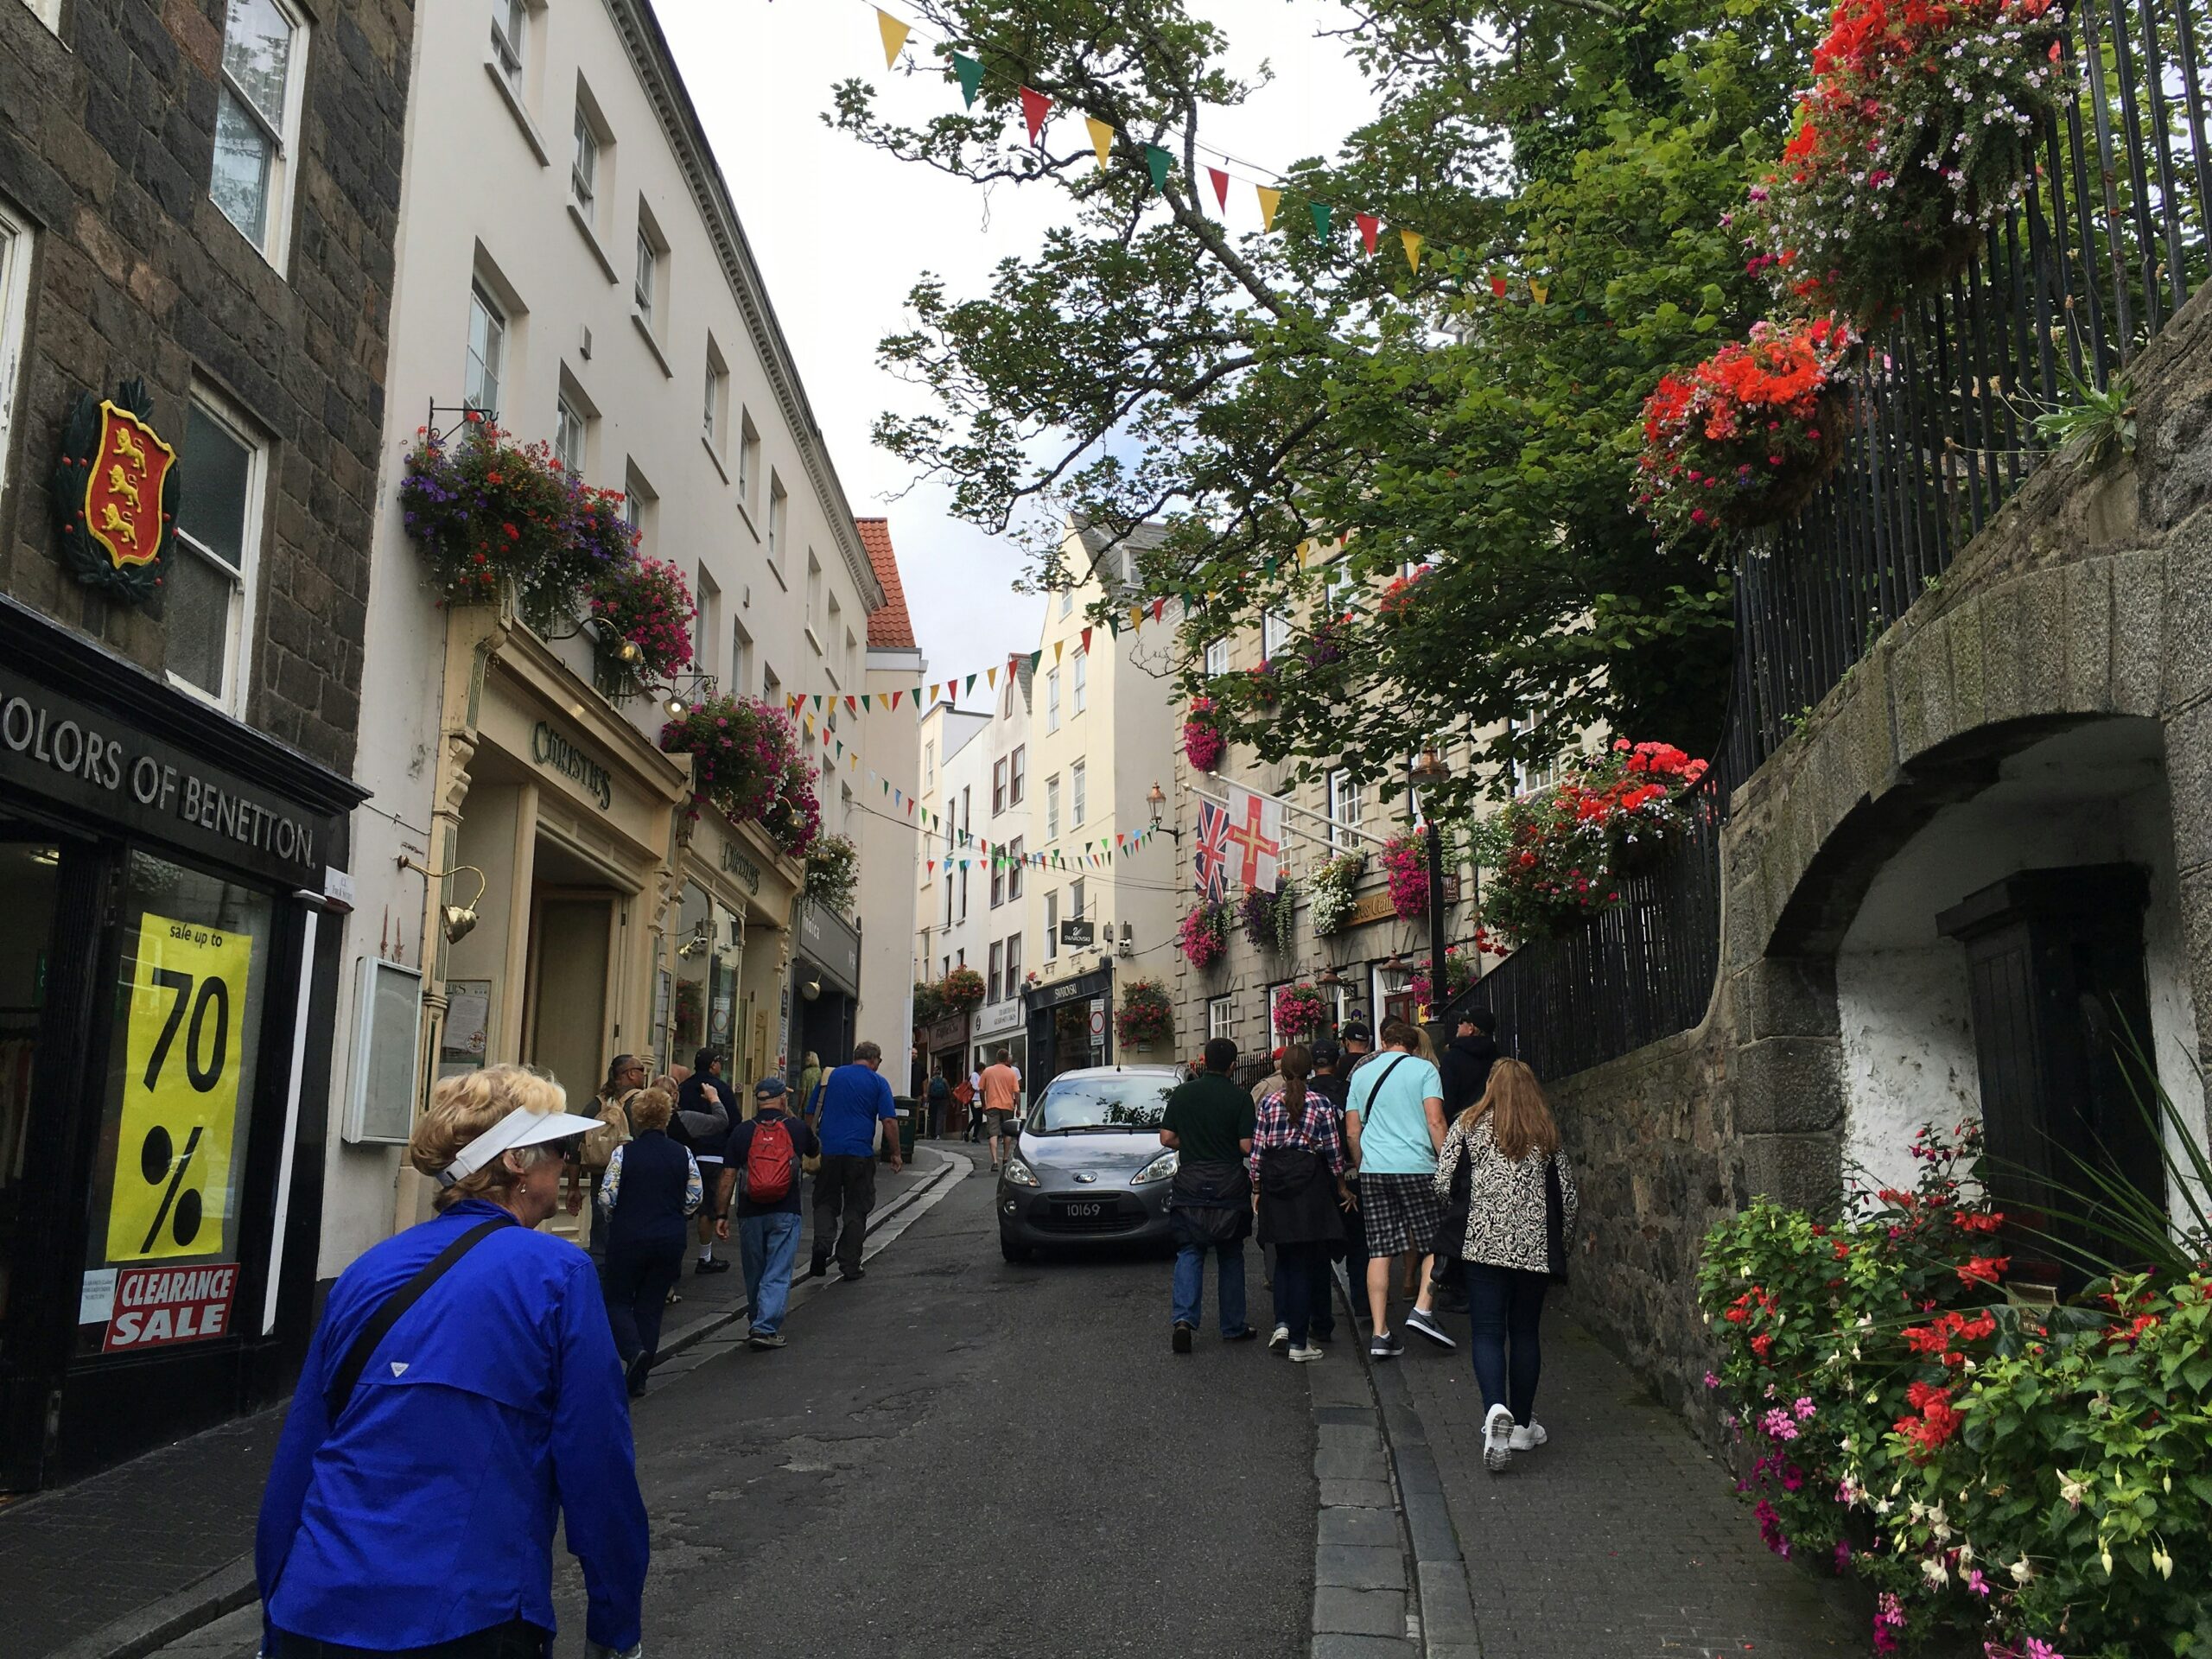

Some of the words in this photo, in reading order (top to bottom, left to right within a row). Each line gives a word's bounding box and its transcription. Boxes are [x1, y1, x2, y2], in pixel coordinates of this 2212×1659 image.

[0, 694, 122, 790] OLORS
[133, 756, 177, 810] OF
[169, 923, 192, 941] sale
[194, 930, 208, 947] up
[211, 931, 223, 947] to
[143, 967, 229, 1093] 70
[139, 1125, 204, 1255] %
[1067, 1204, 1101, 1216] 10169
[121, 1268, 234, 1307] CLEARANCE
[111, 1303, 226, 1345] SALE
